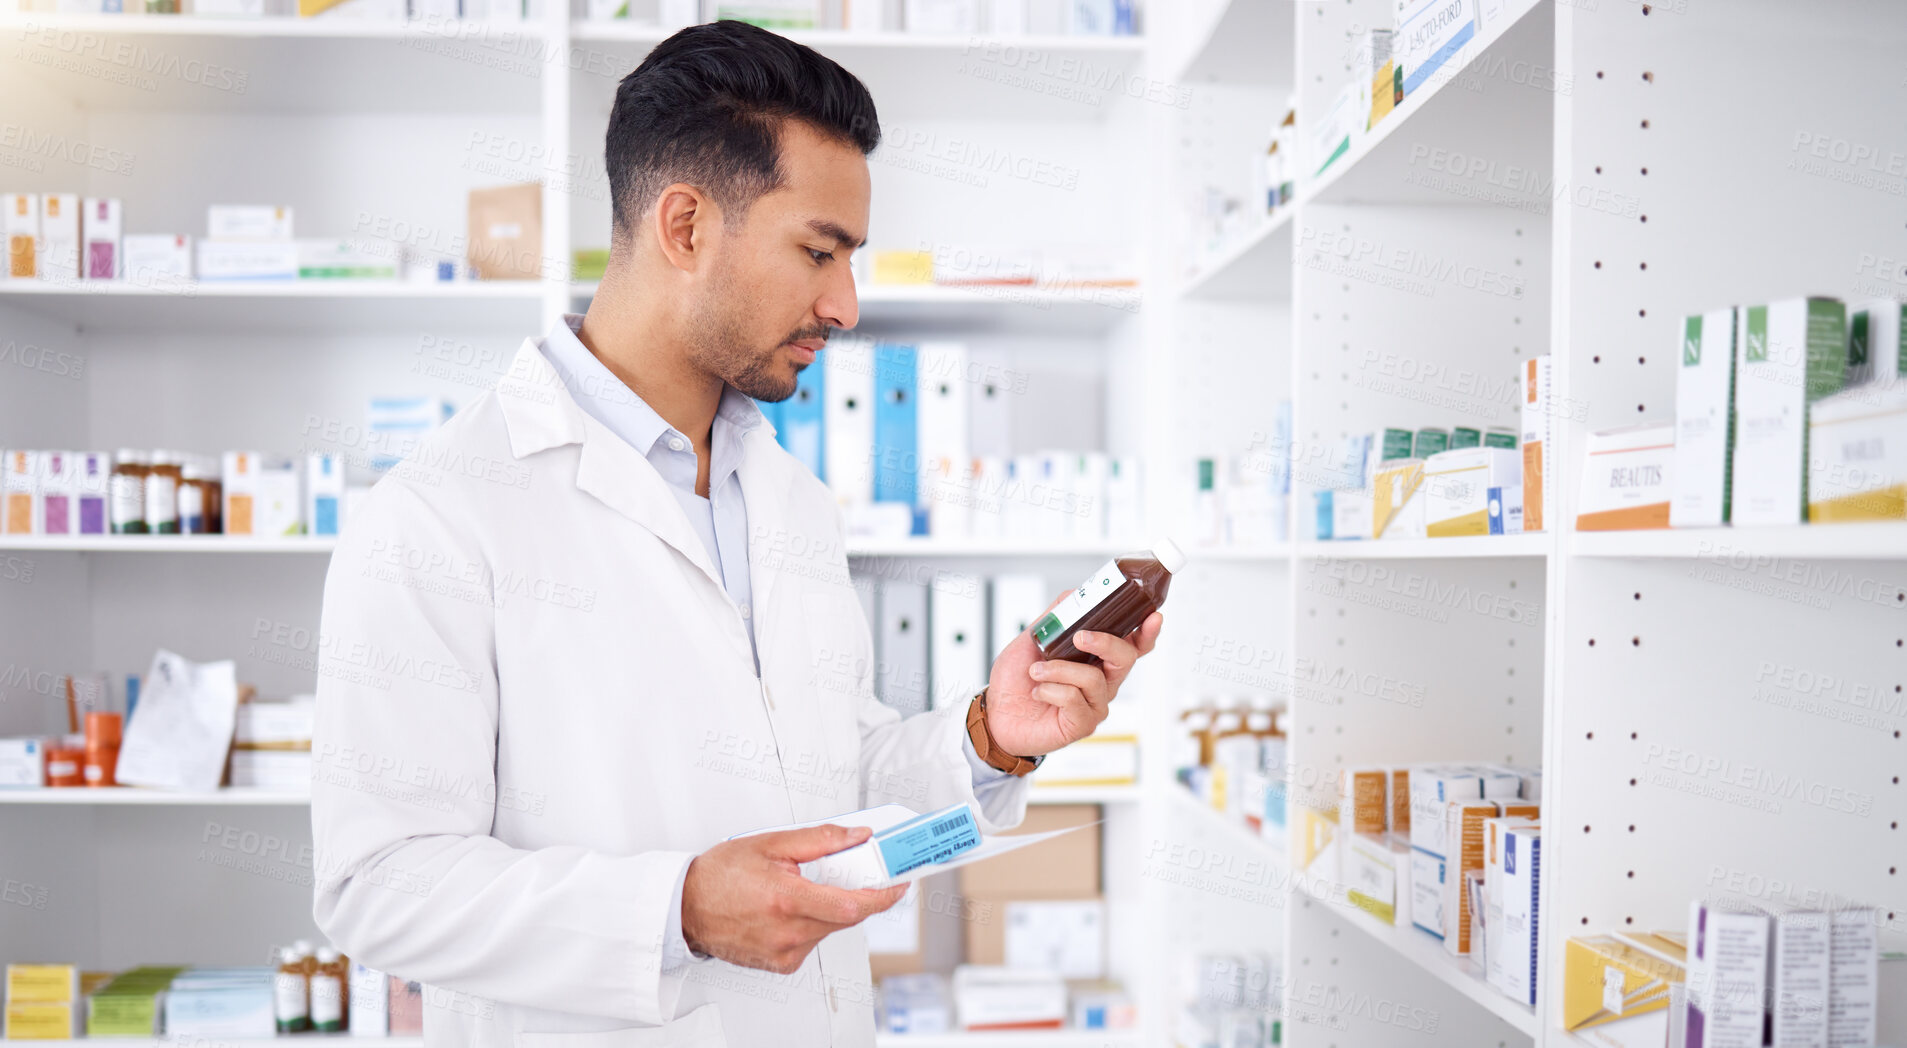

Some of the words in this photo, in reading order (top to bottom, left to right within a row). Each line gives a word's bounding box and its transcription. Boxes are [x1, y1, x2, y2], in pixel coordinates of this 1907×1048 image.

[1410, 0, 1462, 51] LACTO-FORD
[1610, 464, 1662, 488] BEAUTIS
[953, 837, 976, 851] Allergy
[933, 848, 953, 862] Relief
